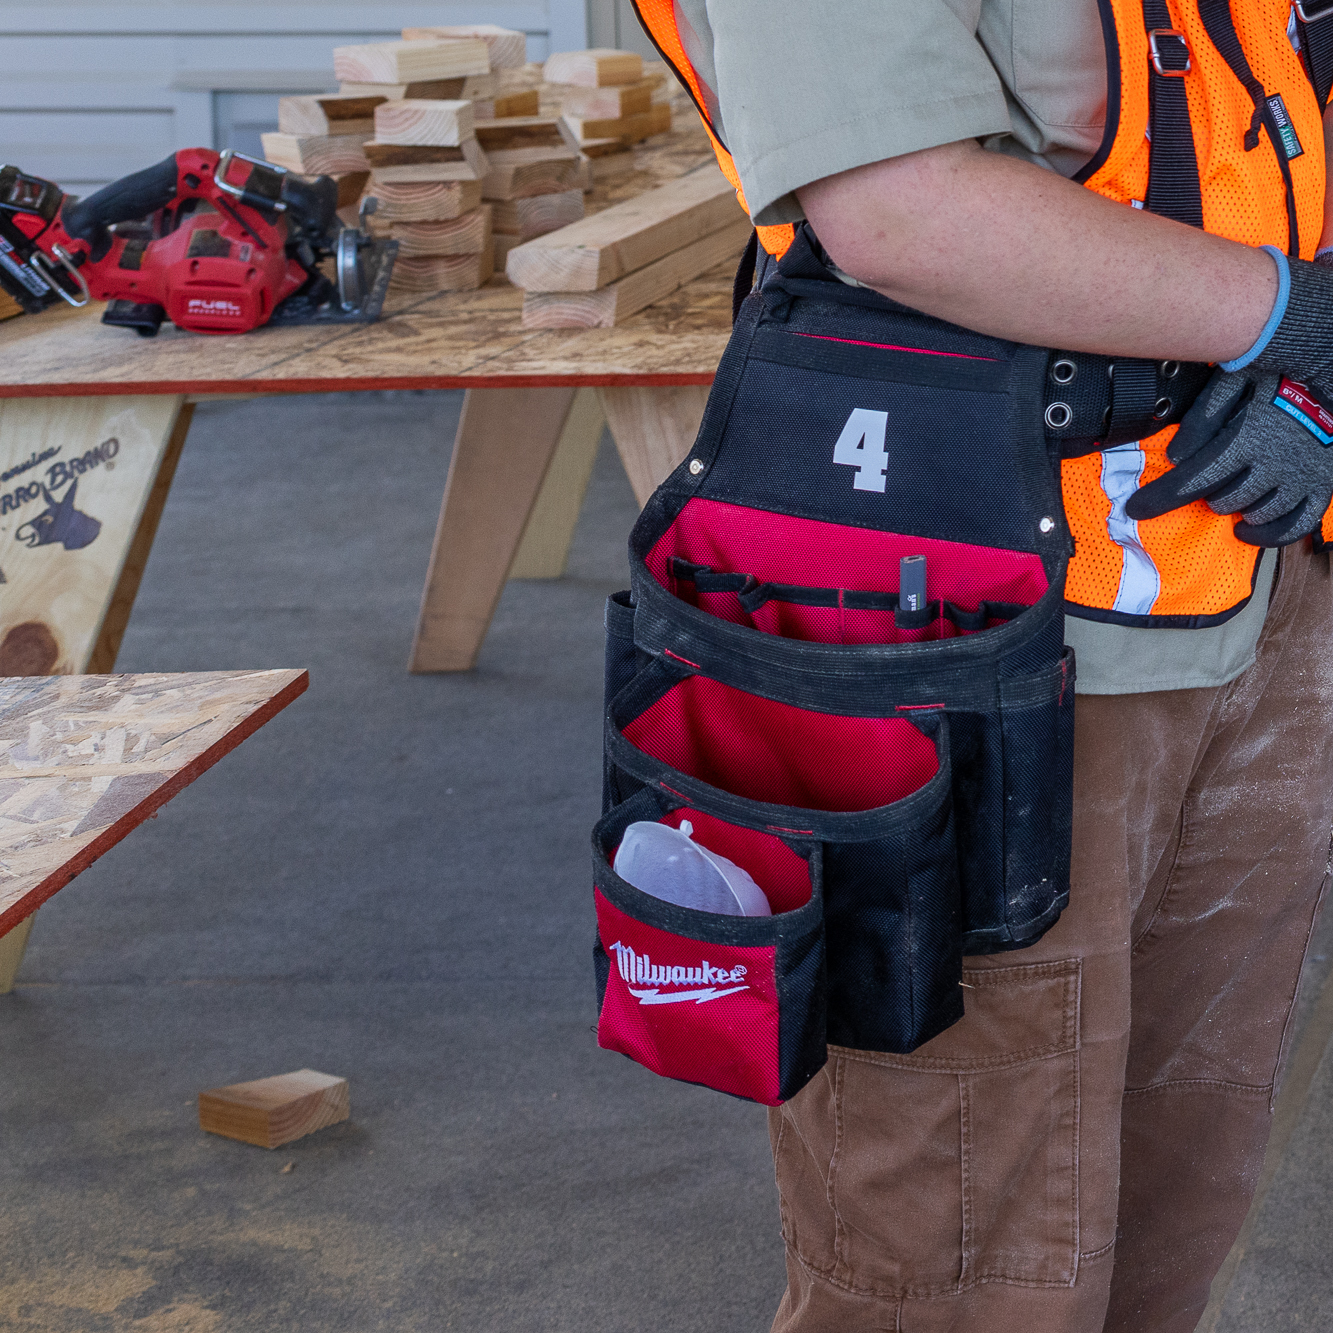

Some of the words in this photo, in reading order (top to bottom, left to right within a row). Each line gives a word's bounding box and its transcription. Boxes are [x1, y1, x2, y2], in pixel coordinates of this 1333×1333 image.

[1268, 98, 1287, 126] WORKS
[1278, 124, 1297, 157] SAFETY
[188, 298, 240, 311] FUEL
[1294, 394, 1303, 404] M
[1286, 404, 1299, 417] CUT
[1300, 414, 1317, 433] LEVEL
[45, 437, 120, 491] BRAND
[832, 408, 889, 493] 4
[609, 940, 744, 987] Milwaukee
